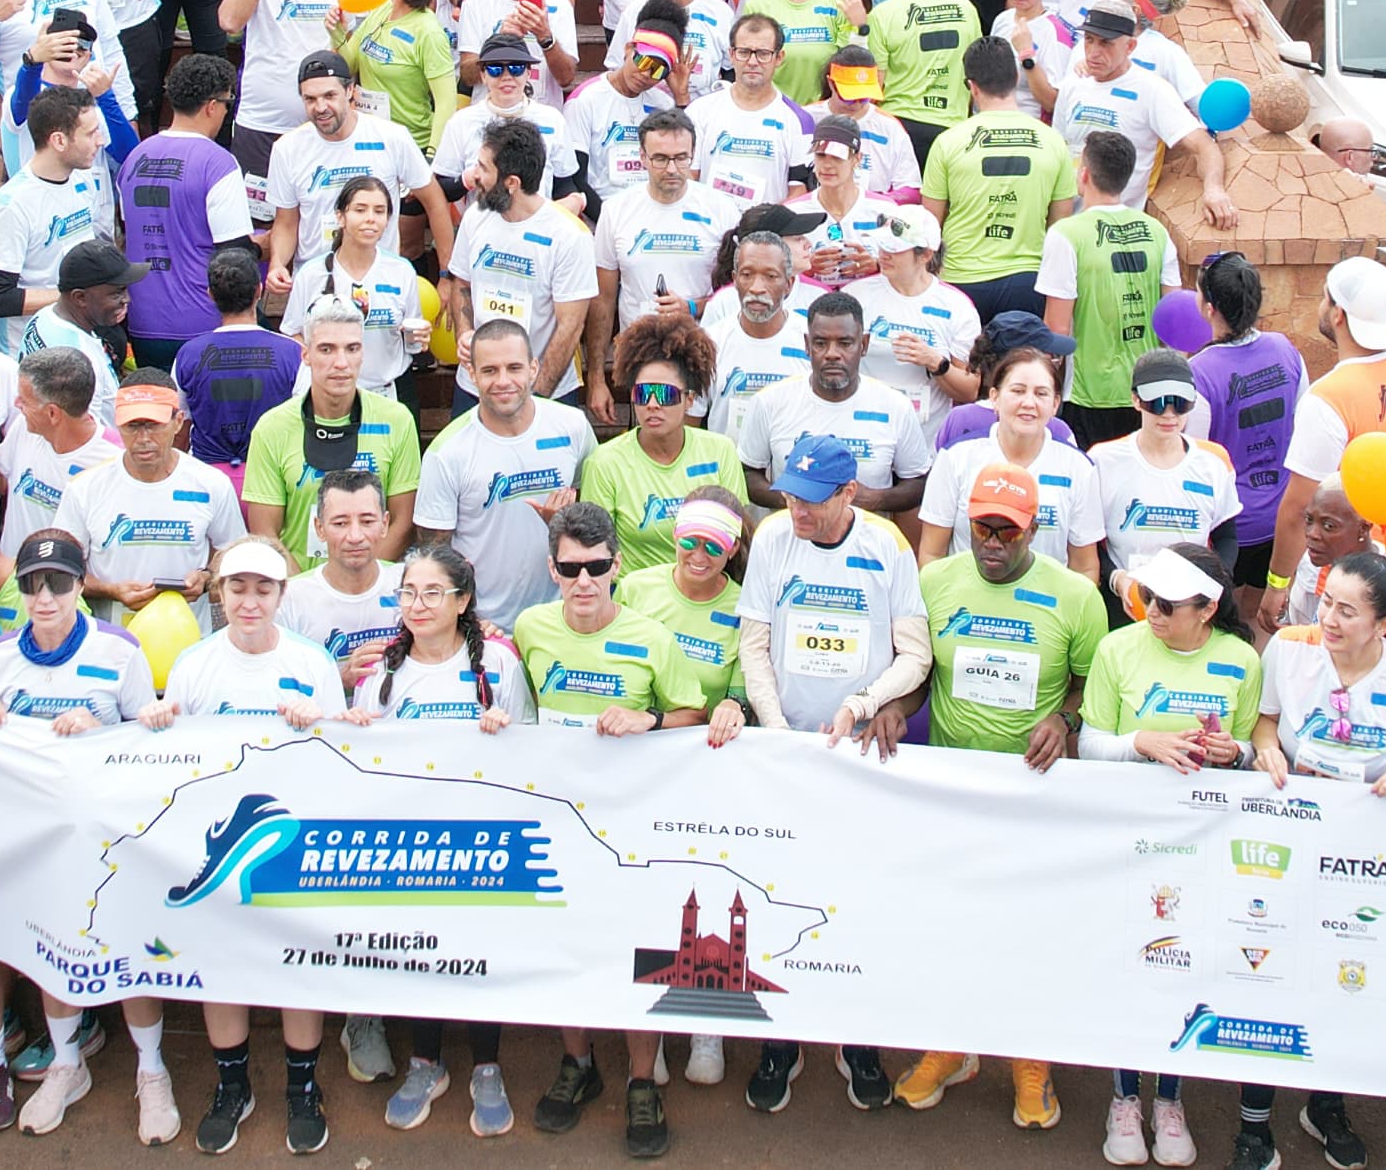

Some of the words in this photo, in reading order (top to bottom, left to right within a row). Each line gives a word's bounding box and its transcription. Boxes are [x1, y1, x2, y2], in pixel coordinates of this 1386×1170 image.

[489, 300, 513, 315] 041
[133, 527, 186, 536] REVEZAMENTO
[805, 592, 857, 604] REVEZAMENTO
[971, 624, 1025, 637] REVEZAMENTO
[806, 636, 845, 652] 033
[965, 667, 1000, 679] GUIA
[1004, 671, 1021, 682] 26
[566, 677, 616, 690] REVEZAMENTO
[1168, 698, 1222, 710] REVEZAMENTO
[104, 753, 201, 765] ARAGUARI
[1191, 790, 1229, 804] FUTEL
[304, 830, 452, 846] CORRIDA
[474, 831, 512, 847] DE
[735, 826, 759, 837] DO
[764, 828, 797, 840] SUL
[1151, 841, 1198, 856] Sicredi
[1241, 841, 1280, 867] life
[300, 849, 510, 873] REVEZAMENTO
[299, 873, 382, 888] UBERLÂNDIA
[396, 875, 457, 887] ROMARIA
[471, 876, 505, 887] 2024
[367, 931, 439, 954] Edição
[36, 940, 130, 978] PARQUE
[282, 948, 306, 966] 27
[311, 950, 337, 967] de
[342, 952, 398, 971] Julho
[403, 957, 430, 973] de
[436, 958, 488, 977] 2024
[1145, 955, 1191, 968] MILITAR
[783, 959, 862, 975] ROMARIA
[68, 978, 106, 994] DO
[117, 969, 204, 990] SABIÁ
[1217, 1028, 1294, 1046] REVEZAMENTO
